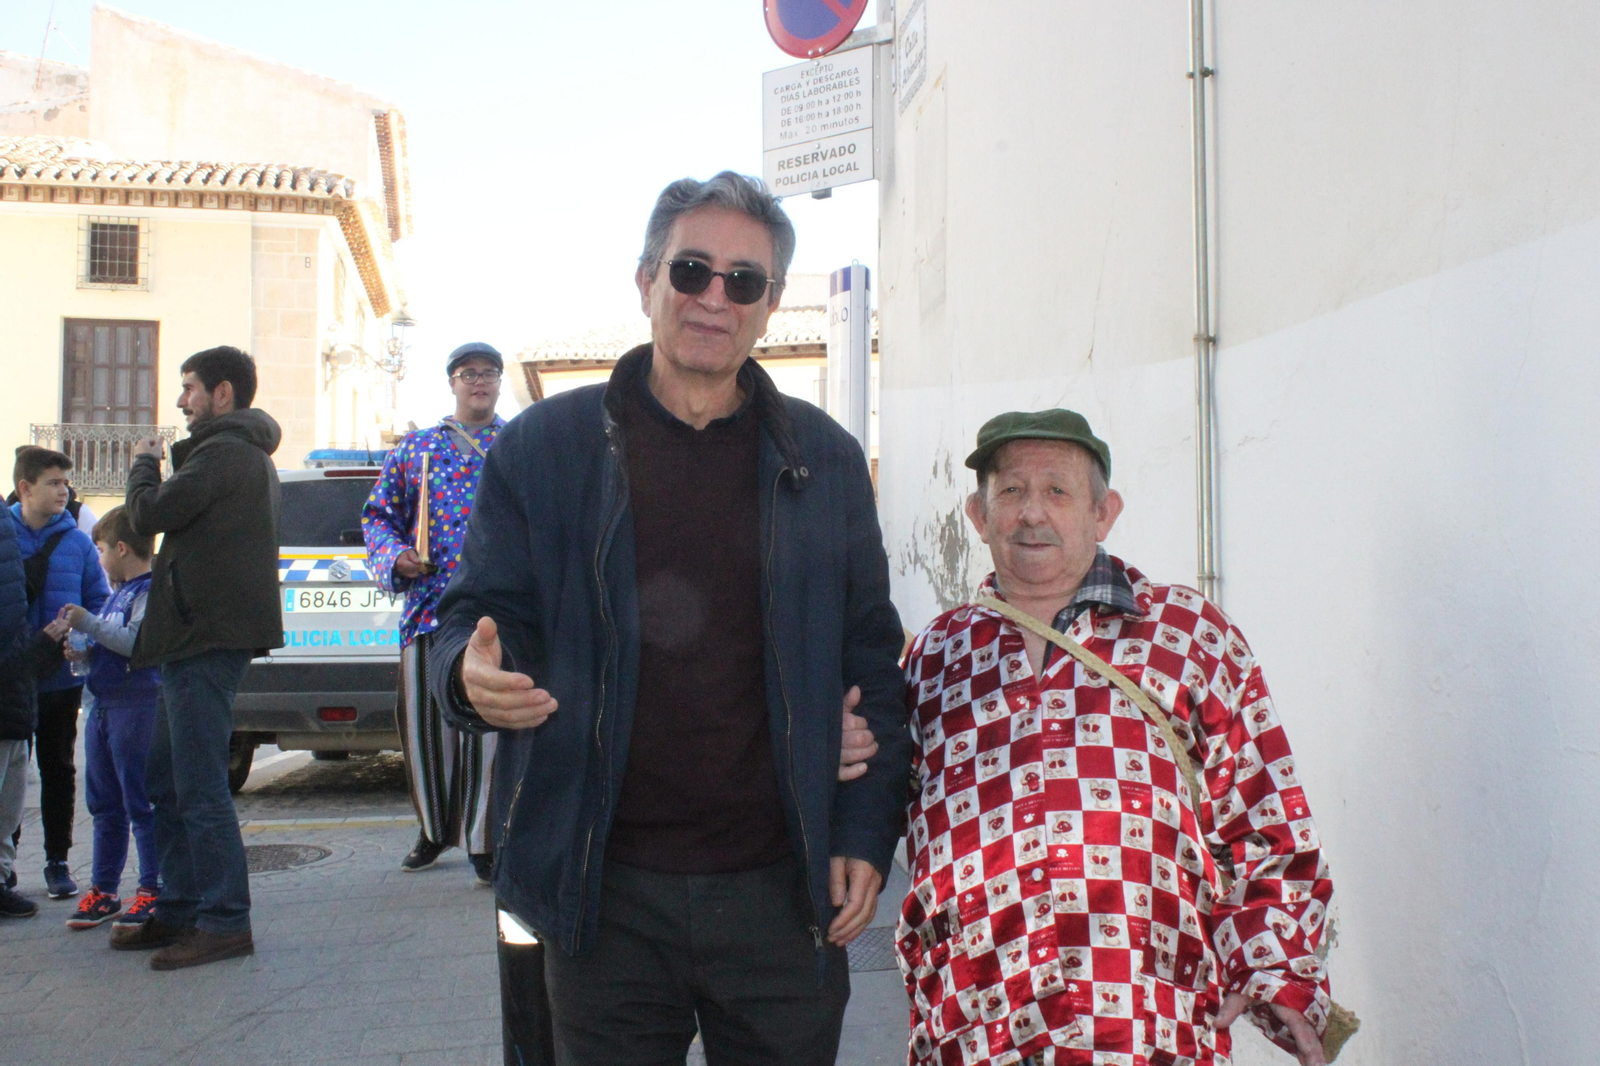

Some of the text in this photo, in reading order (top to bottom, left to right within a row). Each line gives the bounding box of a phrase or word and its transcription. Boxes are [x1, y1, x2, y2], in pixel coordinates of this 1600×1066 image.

[773, 67, 859, 95] CARGA Y DESCARGA
[800, 63, 834, 79] EXCEPTO
[802, 76, 860, 99] LABORABLES
[780, 105, 792, 117] DE
[793, 100, 816, 113] 09:00
[832, 90, 854, 103] 12:00
[780, 116, 792, 128] DE
[794, 112, 816, 124] 16:00
[824, 110, 830, 118] a
[832, 103, 854, 116] 18:00
[805, 124, 817, 135] 20
[820, 115, 860, 132] minutos
[777, 142, 857, 172] RESERVADO
[774, 161, 860, 188] POLICIA LOCAL
[300, 590, 398, 608] 6846 JPV
